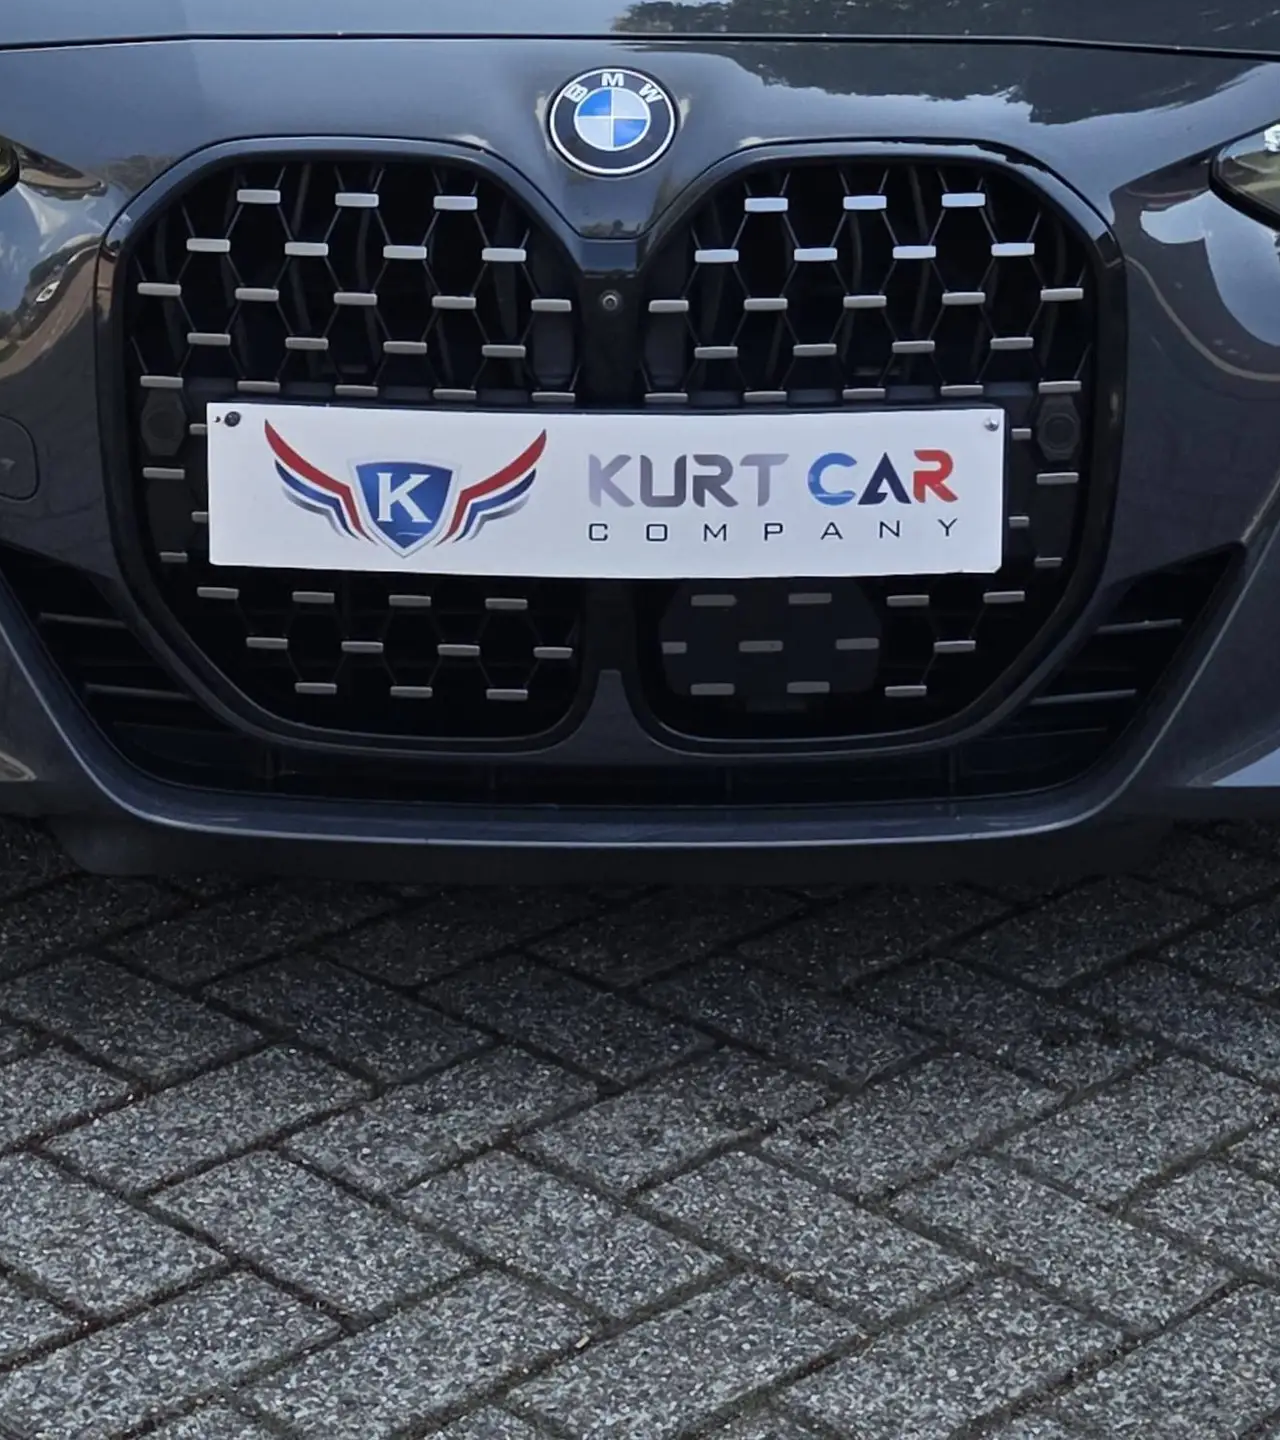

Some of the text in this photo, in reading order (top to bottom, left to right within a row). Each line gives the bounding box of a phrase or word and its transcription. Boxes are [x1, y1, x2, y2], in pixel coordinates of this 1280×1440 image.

[563, 72, 664, 104] BMW
[376, 471, 432, 523] K
[588, 448, 959, 508] KURT CAR
[588, 517, 959, 543] COMPANY
